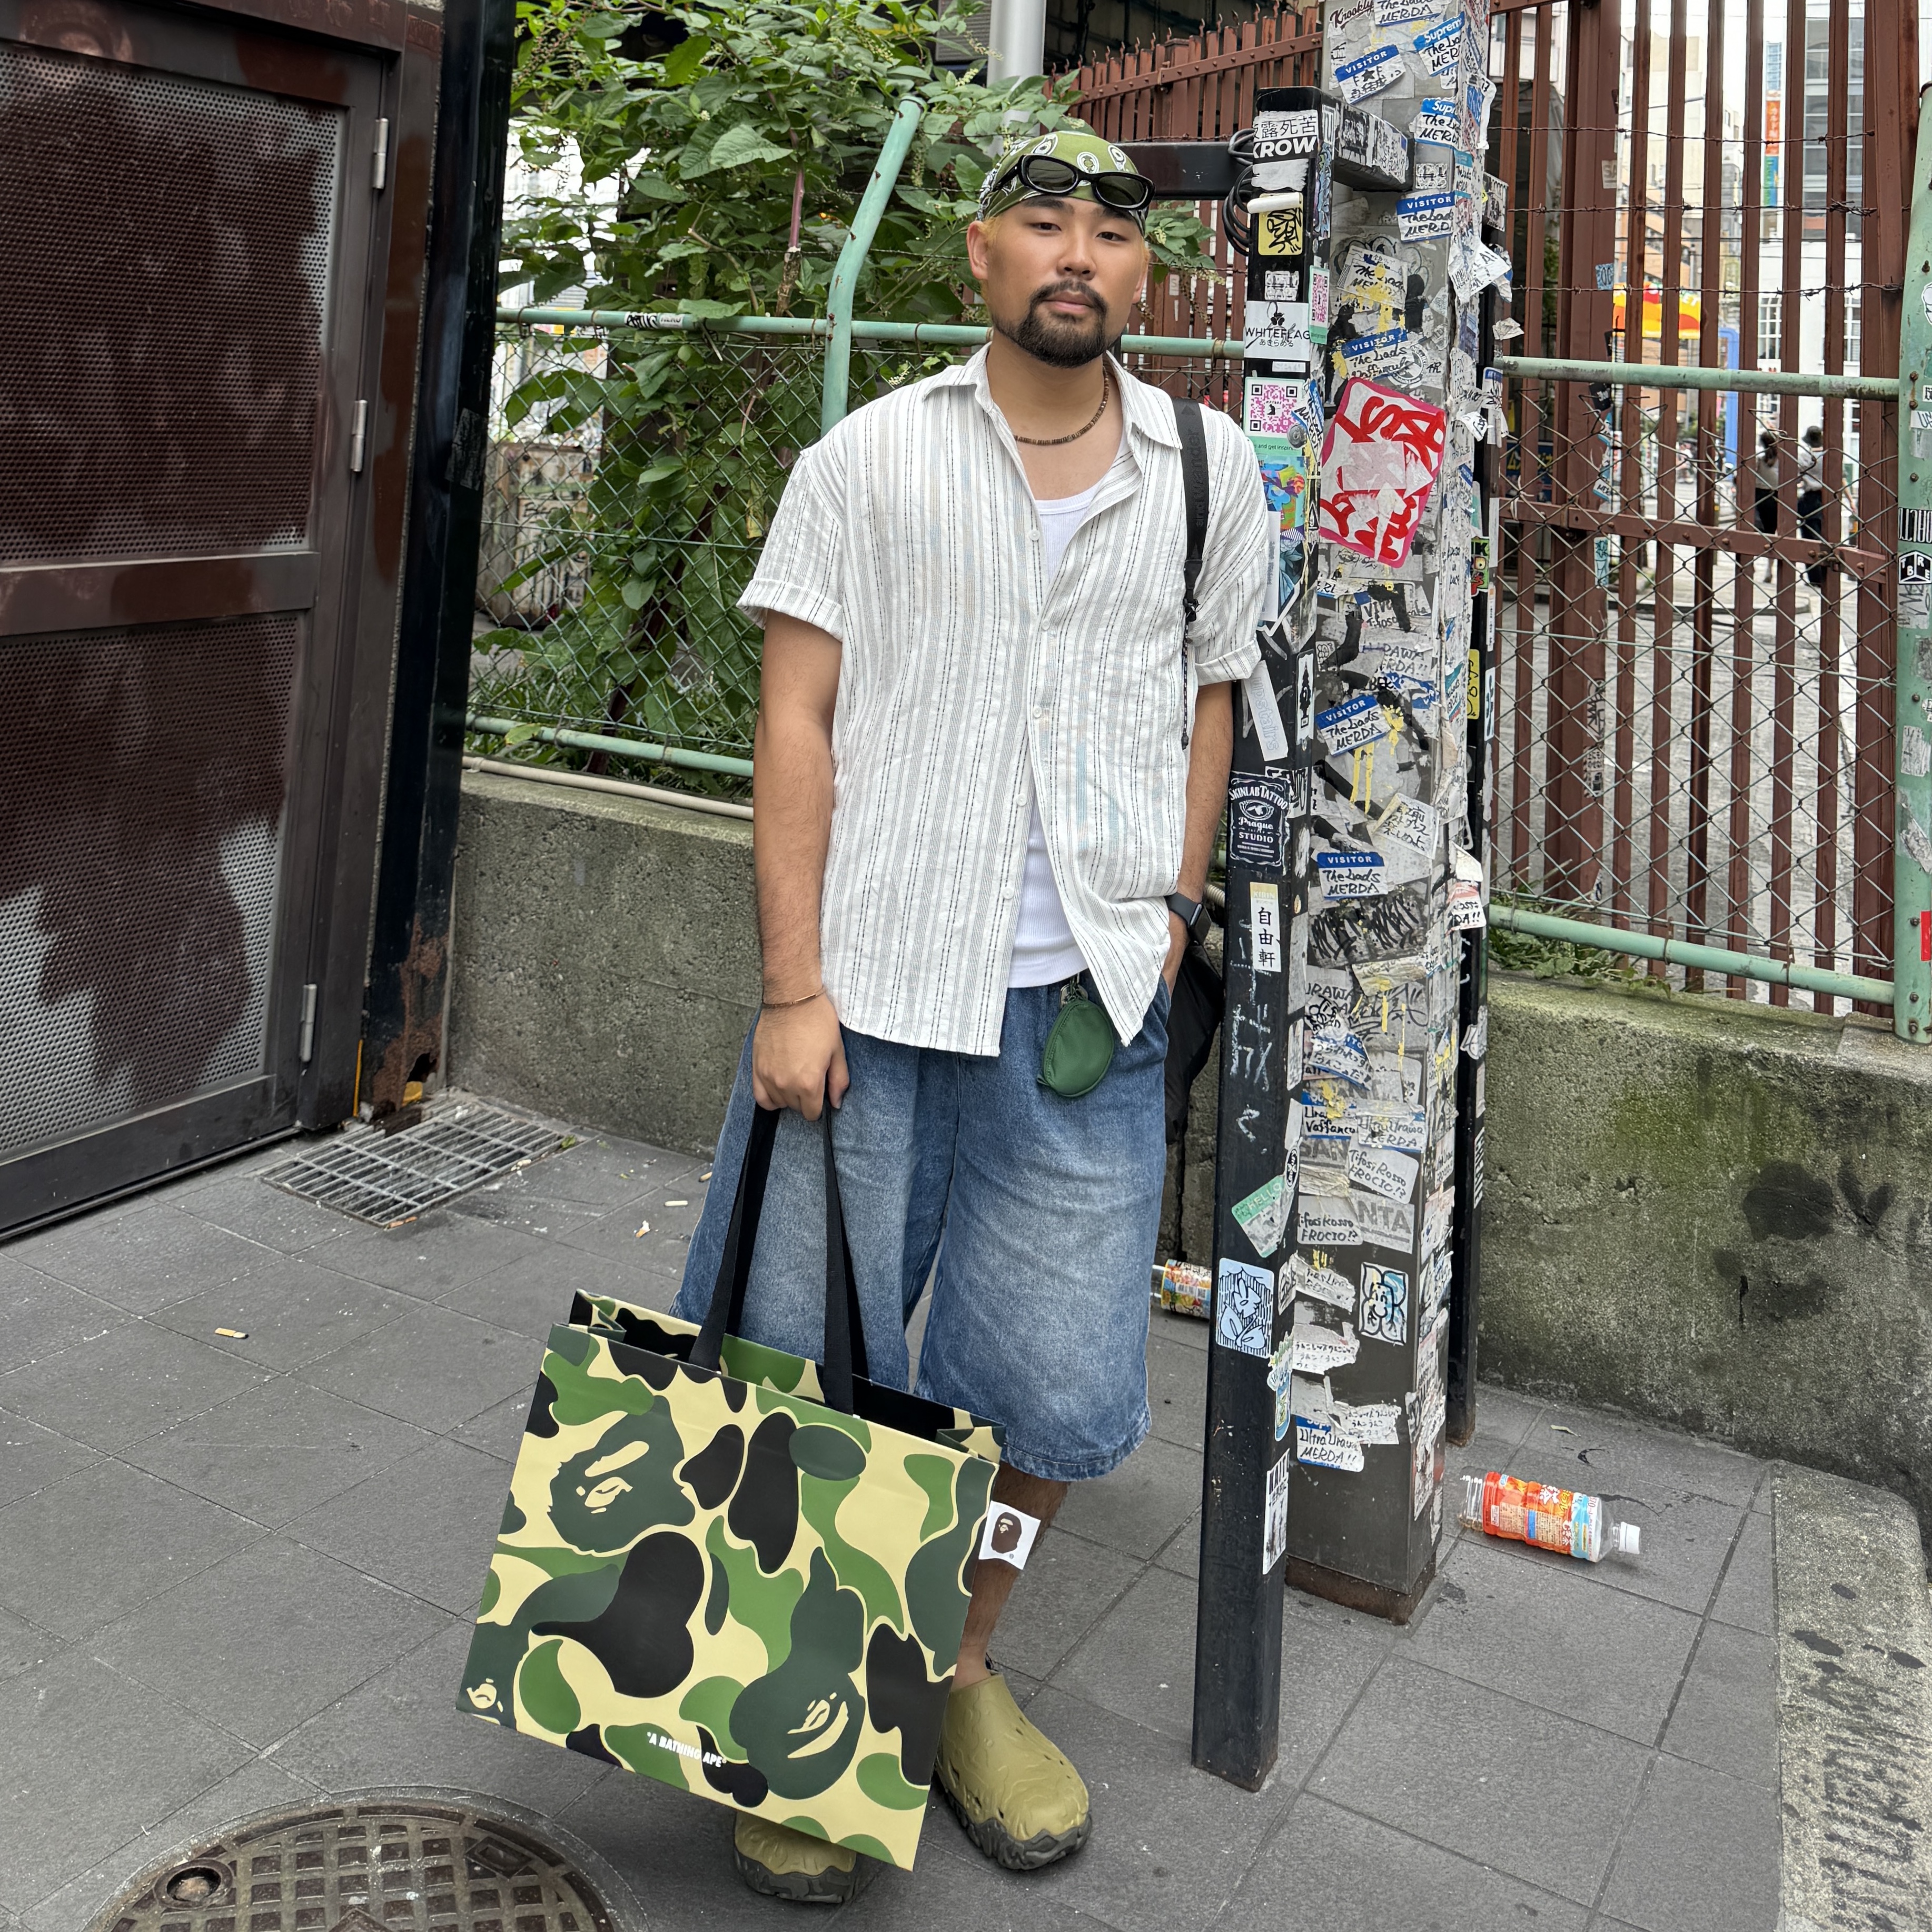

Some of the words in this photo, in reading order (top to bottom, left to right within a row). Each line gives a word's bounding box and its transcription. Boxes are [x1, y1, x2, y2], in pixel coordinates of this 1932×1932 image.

[1379, 4, 1433, 23] MERDA
[1424, 44, 1446, 57] The
[1345, 51, 1388, 74] VISITOR
[1432, 47, 1460, 72] MER
[1422, 114, 1445, 127] The
[1407, 196, 1452, 209] VISITOR
[1401, 212, 1421, 223] The
[1404, 222, 1452, 237] MERD
[1245, 327, 1311, 340] WHITEFLAG
[1259, 339, 1294, 348] あきらめる
[1352, 334, 1395, 351] VISITOR
[1350, 355, 1372, 368] The
[1373, 342, 1408, 361] Lads
[1250, 677, 1279, 751] upstairs
[1326, 700, 1365, 721] VISITOR
[1326, 725, 1348, 737] The
[1348, 711, 1380, 729] Lads
[1336, 724, 1382, 750] MERDA
[1238, 817, 1273, 832] Prague
[1239, 832, 1274, 843] STUDIO
[1322, 869, 1344, 883] The
[1345, 868, 1381, 883] Lads
[1327, 883, 1380, 896] MERDA
[1258, 906, 1275, 968] 自由軒
[1349, 1150, 1376, 1171] Tifosi
[1376, 1162, 1406, 1187] Rosso
[659, 1736, 701, 1760] BATHING
